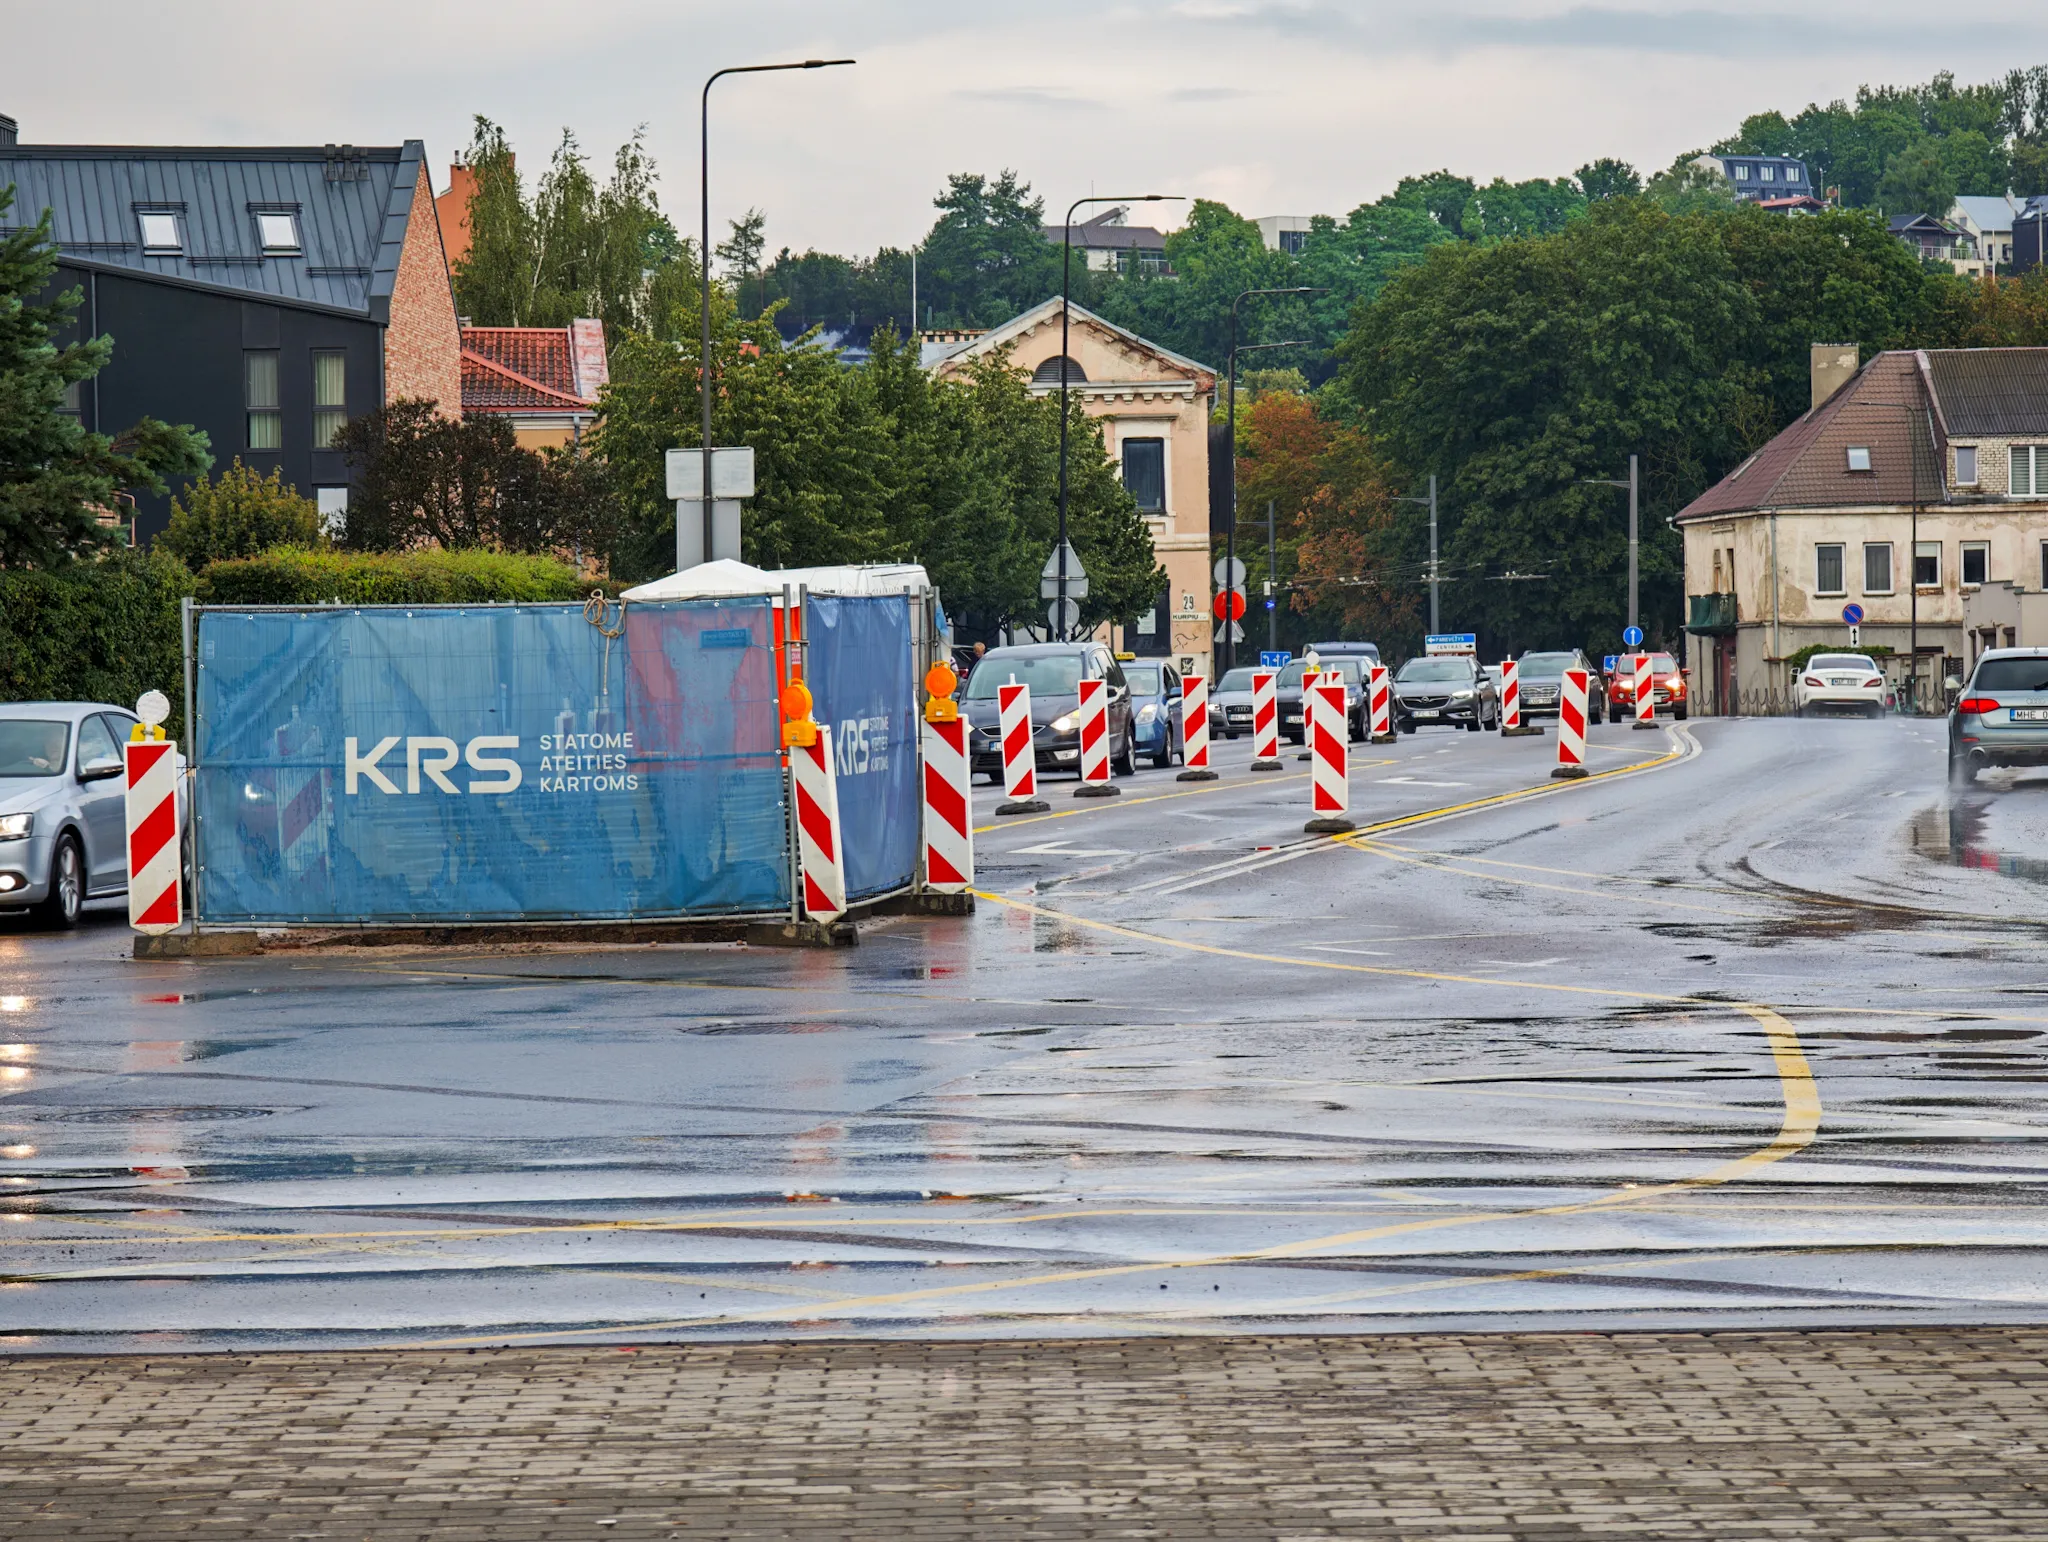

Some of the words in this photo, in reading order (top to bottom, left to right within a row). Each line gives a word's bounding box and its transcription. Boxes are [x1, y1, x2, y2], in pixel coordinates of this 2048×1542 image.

[1183, 595, 1194, 610] 29
[2017, 710, 2036, 719] MHE
[540, 732, 633, 750] STATOME
[836, 719, 869, 776] KRS
[345, 736, 522, 794] KRS
[540, 753, 627, 771] ATEITIES
[540, 775, 639, 793] KARTOMS
